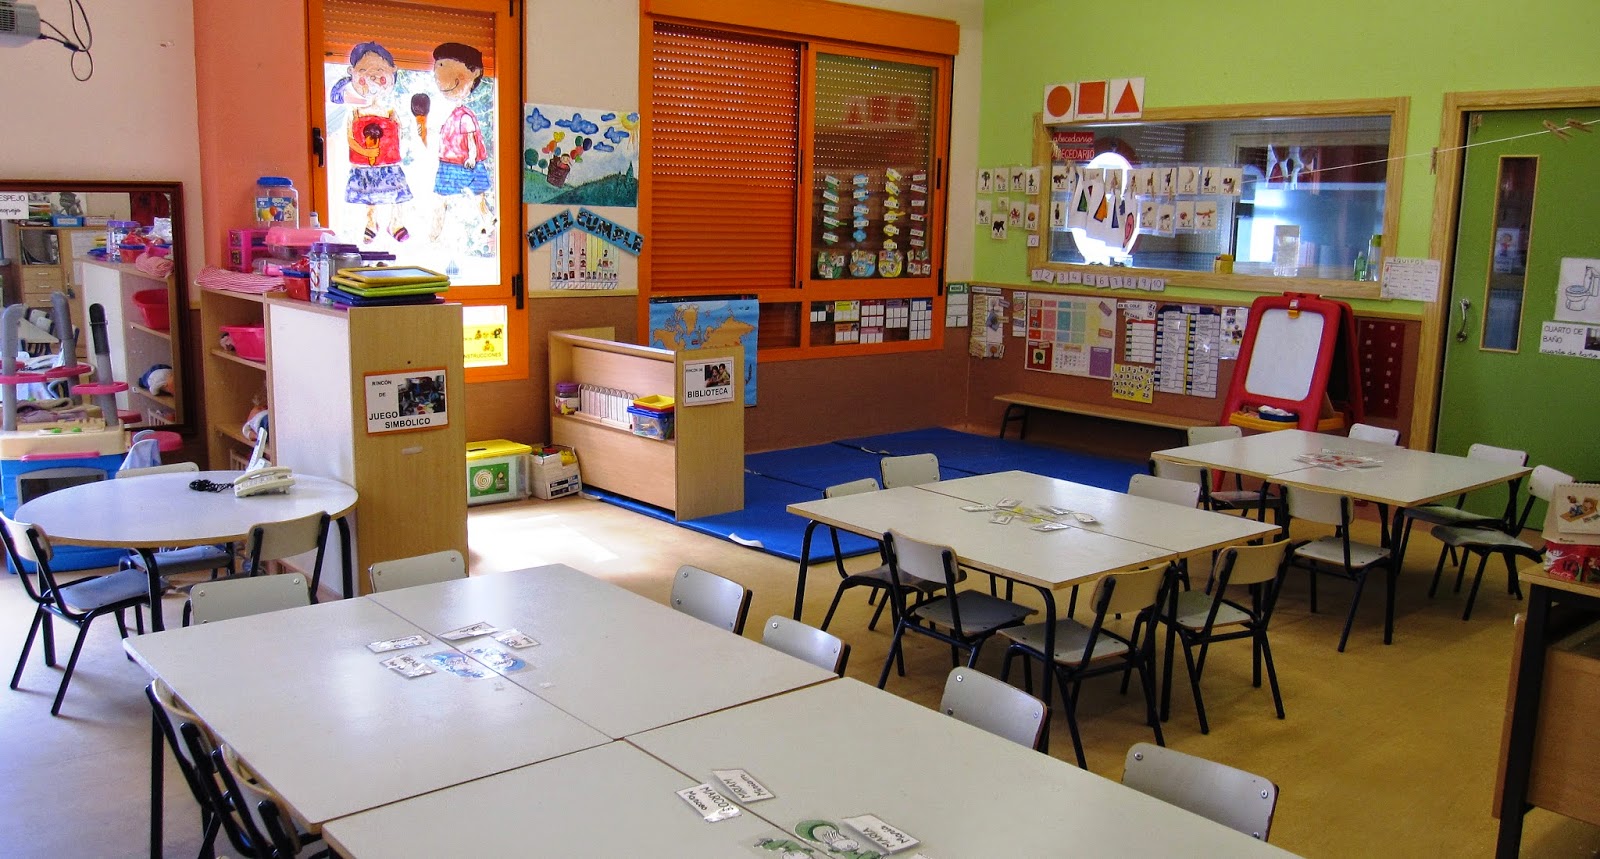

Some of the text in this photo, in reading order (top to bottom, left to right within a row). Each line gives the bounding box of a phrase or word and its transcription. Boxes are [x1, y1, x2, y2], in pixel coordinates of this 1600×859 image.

[1053, 133, 1093, 143] abecedario
[527, 210, 643, 252] FELIZ CUMPLE
[1100, 276, 1104, 285] 6
[1127, 278, 1132, 286] 8
[1142, 279, 1147, 287] 9
[1544, 326, 1571, 335] CUARTO
[1543, 336, 1563, 344] BAÑO
[687, 388, 728, 399] BIBLIOTECA
[369, 411, 398, 421] JUEGO
[385, 417, 431, 429] SIMBÓLICO
